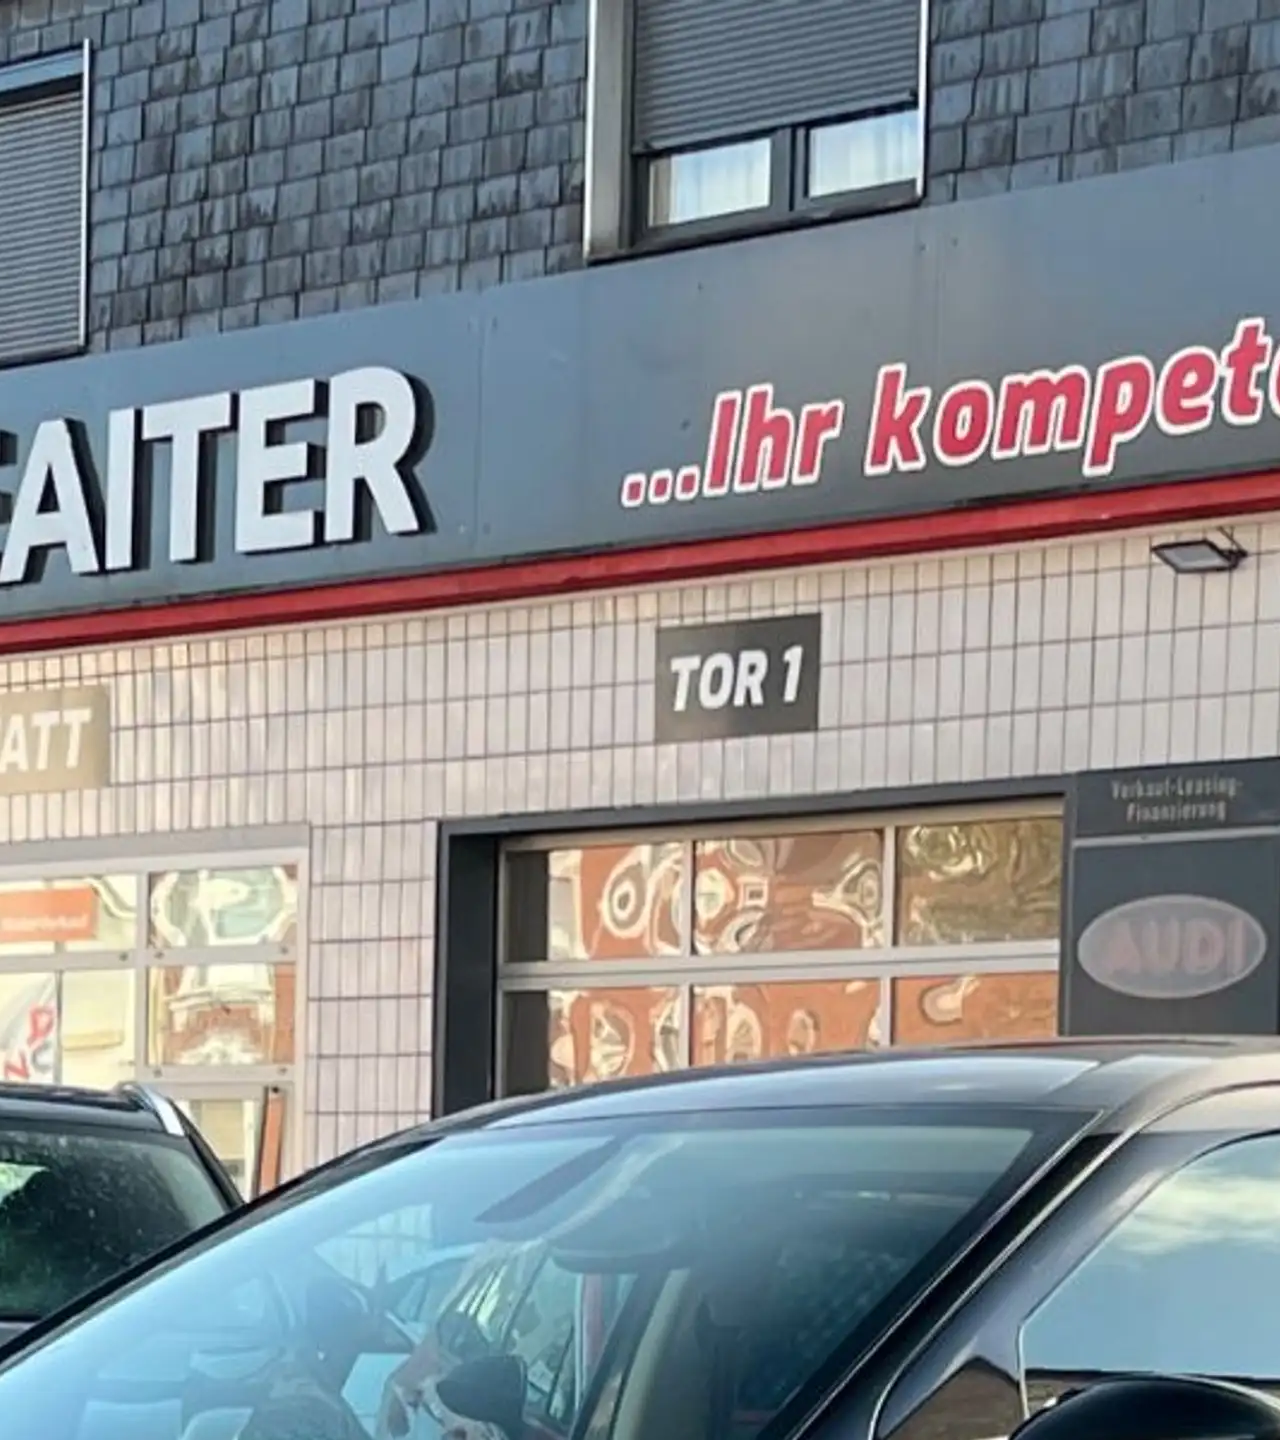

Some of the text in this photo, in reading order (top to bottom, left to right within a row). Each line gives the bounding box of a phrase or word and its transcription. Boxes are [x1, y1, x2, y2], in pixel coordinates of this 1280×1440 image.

[621, 382, 843, 508] ...Ihr
[669, 644, 804, 713] TOR 1
[1126, 800, 1227, 823] Finanzierung
[1103, 916, 1248, 976] AUDI
